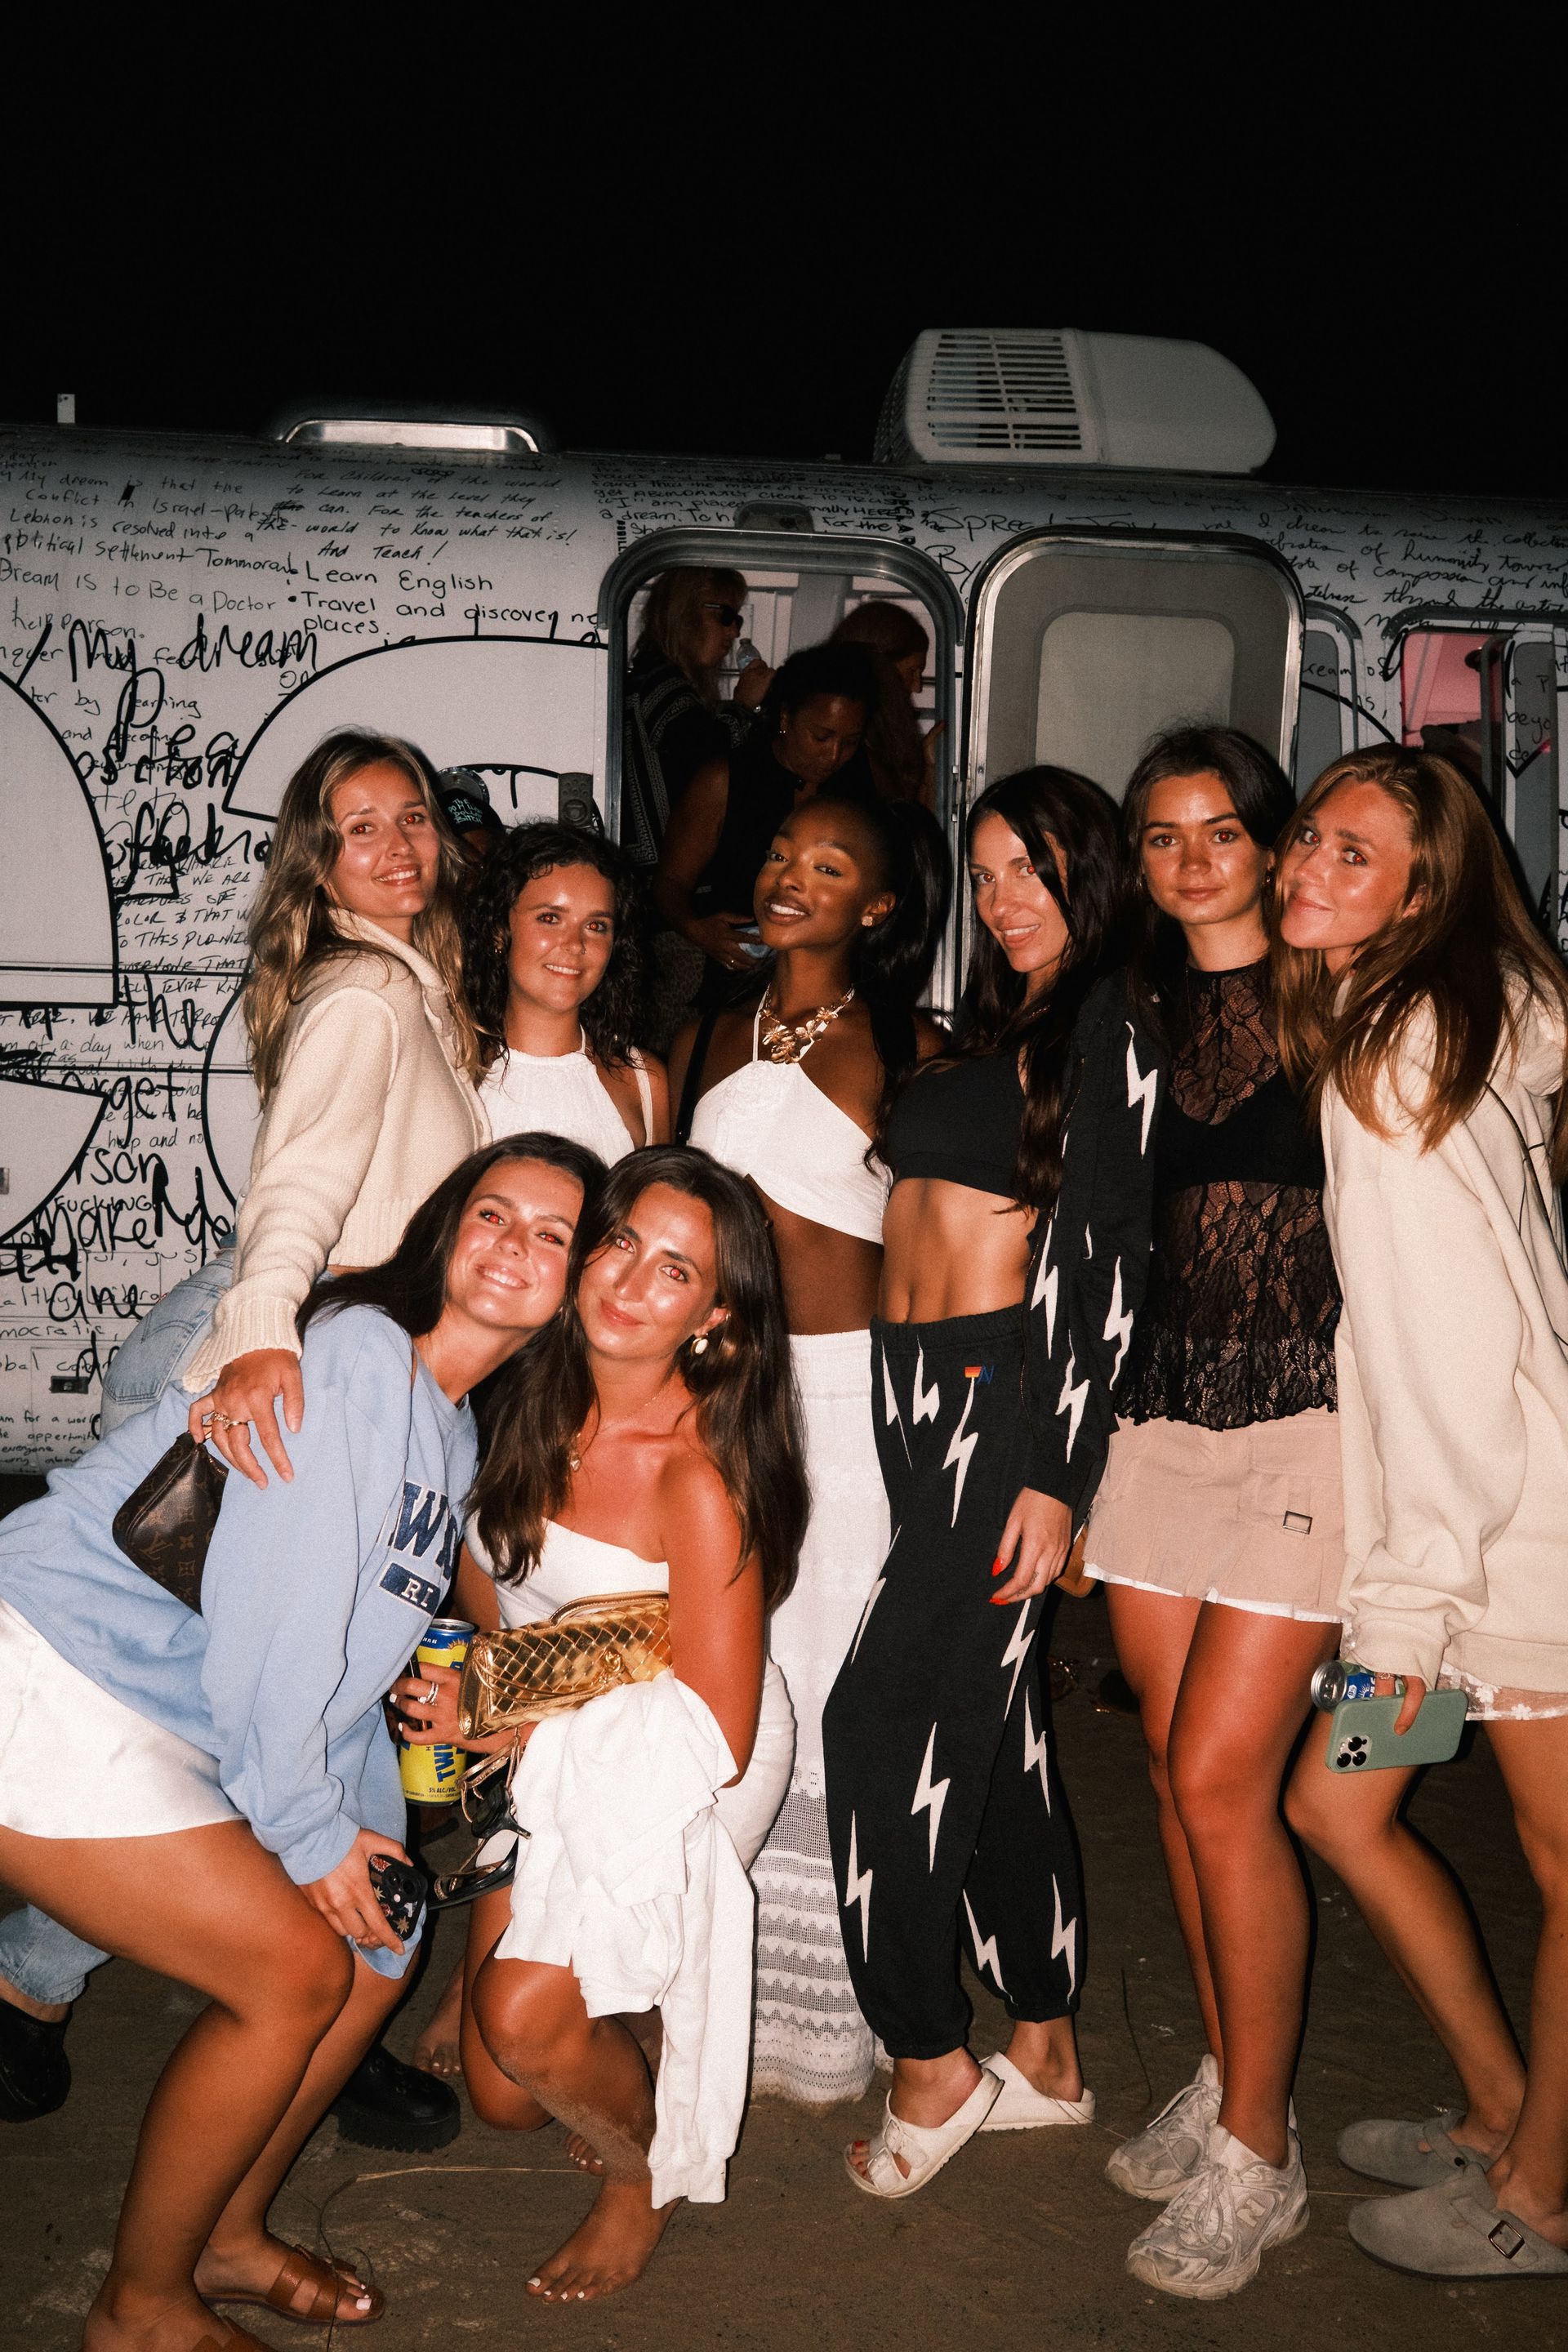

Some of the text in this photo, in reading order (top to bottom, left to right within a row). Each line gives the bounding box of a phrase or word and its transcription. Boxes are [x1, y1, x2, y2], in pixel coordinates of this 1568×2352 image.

[162, 476, 195, 492] that
[214, 483, 243, 494] the
[460, 473, 492, 486] the
[376, 490, 401, 499] at
[411, 488, 437, 501] the
[416, 506, 443, 519] the
[381, 524, 400, 535] to
[1361, 544, 1389, 564] of
[305, 560, 493, 599] Learn English
[114, 577, 140, 595] to
[149, 581, 178, 600] Be
[189, 593, 203, 606] a
[213, 591, 276, 613] Doctor
[300, 590, 376, 614] Travel
[396, 603, 445, 617] and
[74, 689, 100, 715] by
[62, 728, 92, 741] and
[80, 1033, 112, 1059] day
[149, 1128, 177, 1147] and
[24, 1410, 40, 1423] for
